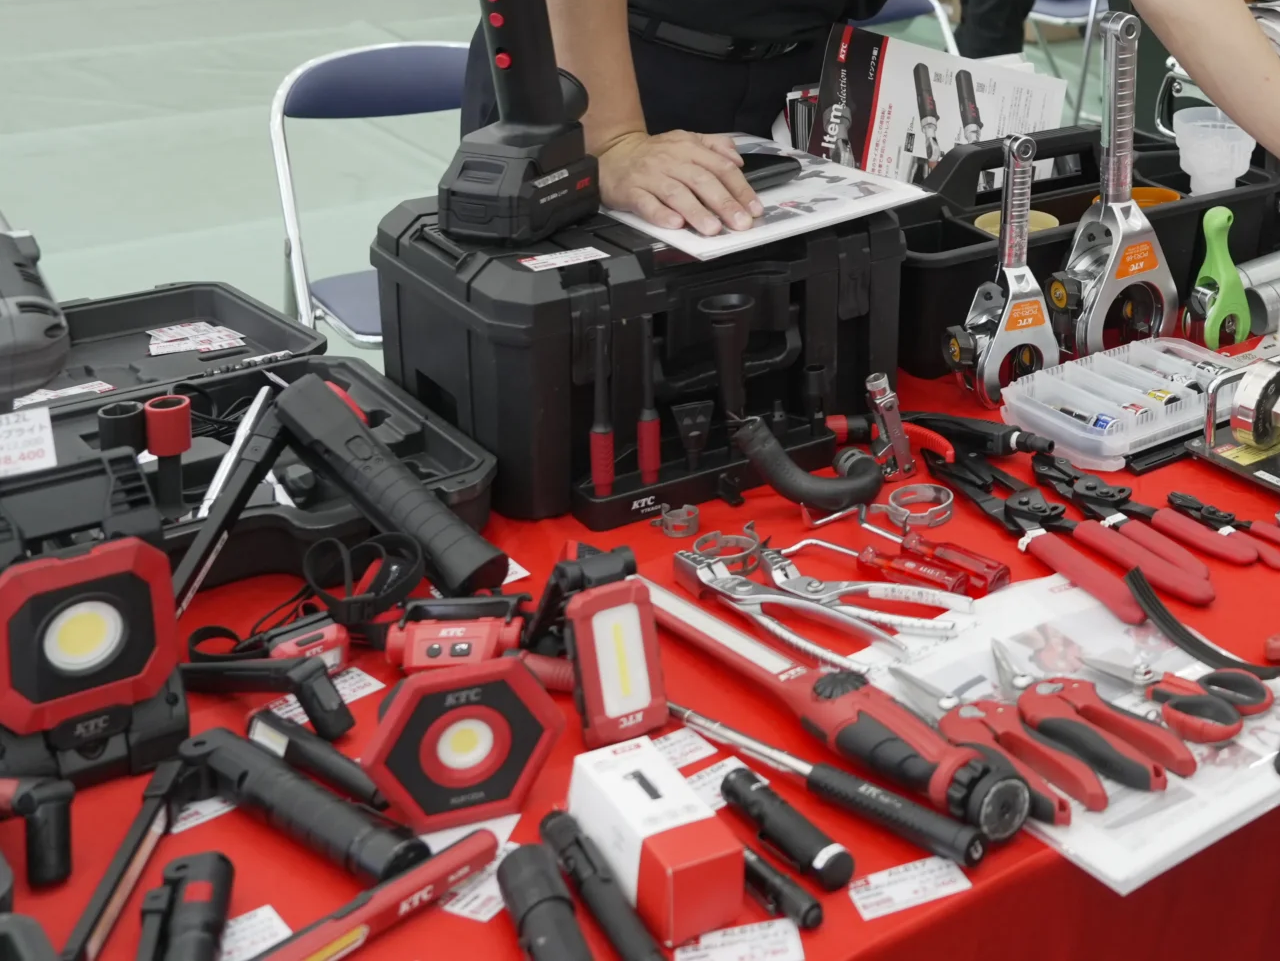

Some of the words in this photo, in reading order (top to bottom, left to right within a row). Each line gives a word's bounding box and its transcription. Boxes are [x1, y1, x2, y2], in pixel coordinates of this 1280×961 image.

[839, 42, 849, 60] KTC
[821, 103, 843, 149] Item
[838, 68, 847, 108] Selection
[1128, 261, 1145, 272] KTC
[1016, 317, 1033, 327] KTC
[631, 496, 655, 510] KTC
[438, 627, 467, 638] KTC
[444, 688, 483, 707] KTC
[73, 715, 110, 736] KTC
[397, 884, 434, 917] KTC
